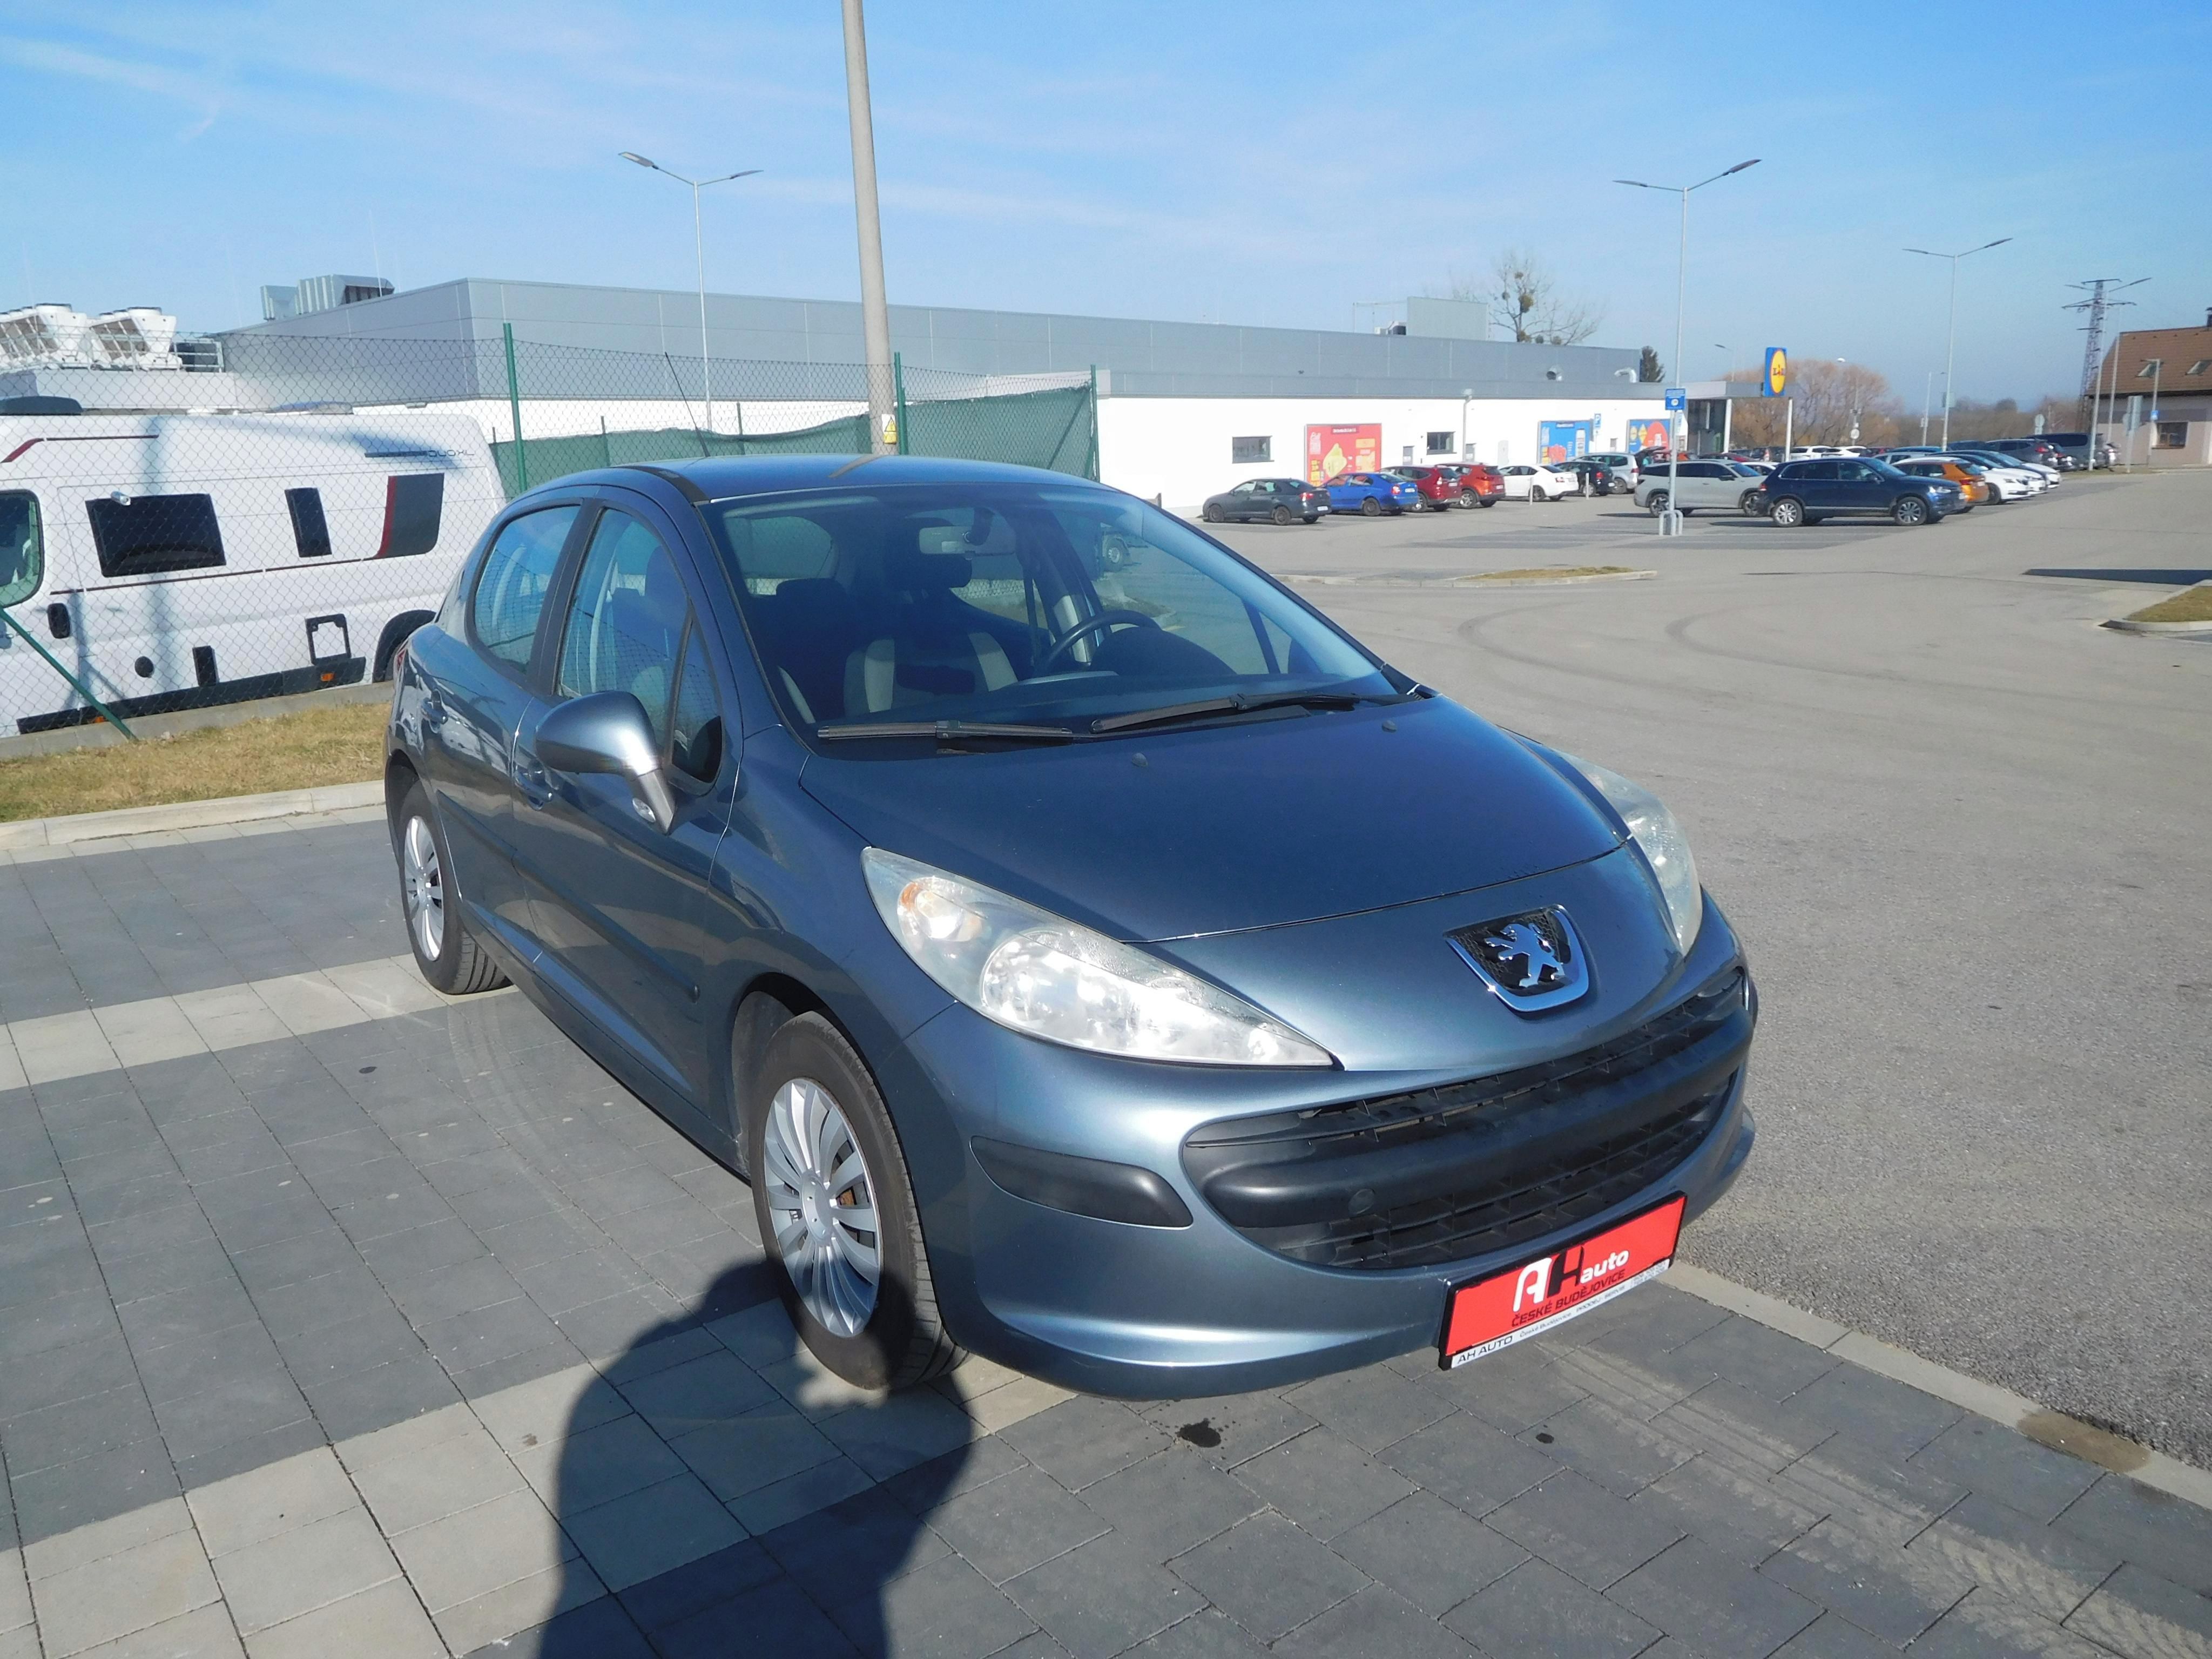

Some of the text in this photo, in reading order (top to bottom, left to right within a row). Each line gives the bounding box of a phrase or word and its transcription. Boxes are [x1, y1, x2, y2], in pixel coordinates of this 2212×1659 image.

[1512, 1300, 1553, 1327] ČESKÉ
[1555, 1269, 1626, 1311] BUDĚJOVICE
[1458, 1350, 1475, 1364] AH
[1478, 1335, 1513, 1355] AUTO
